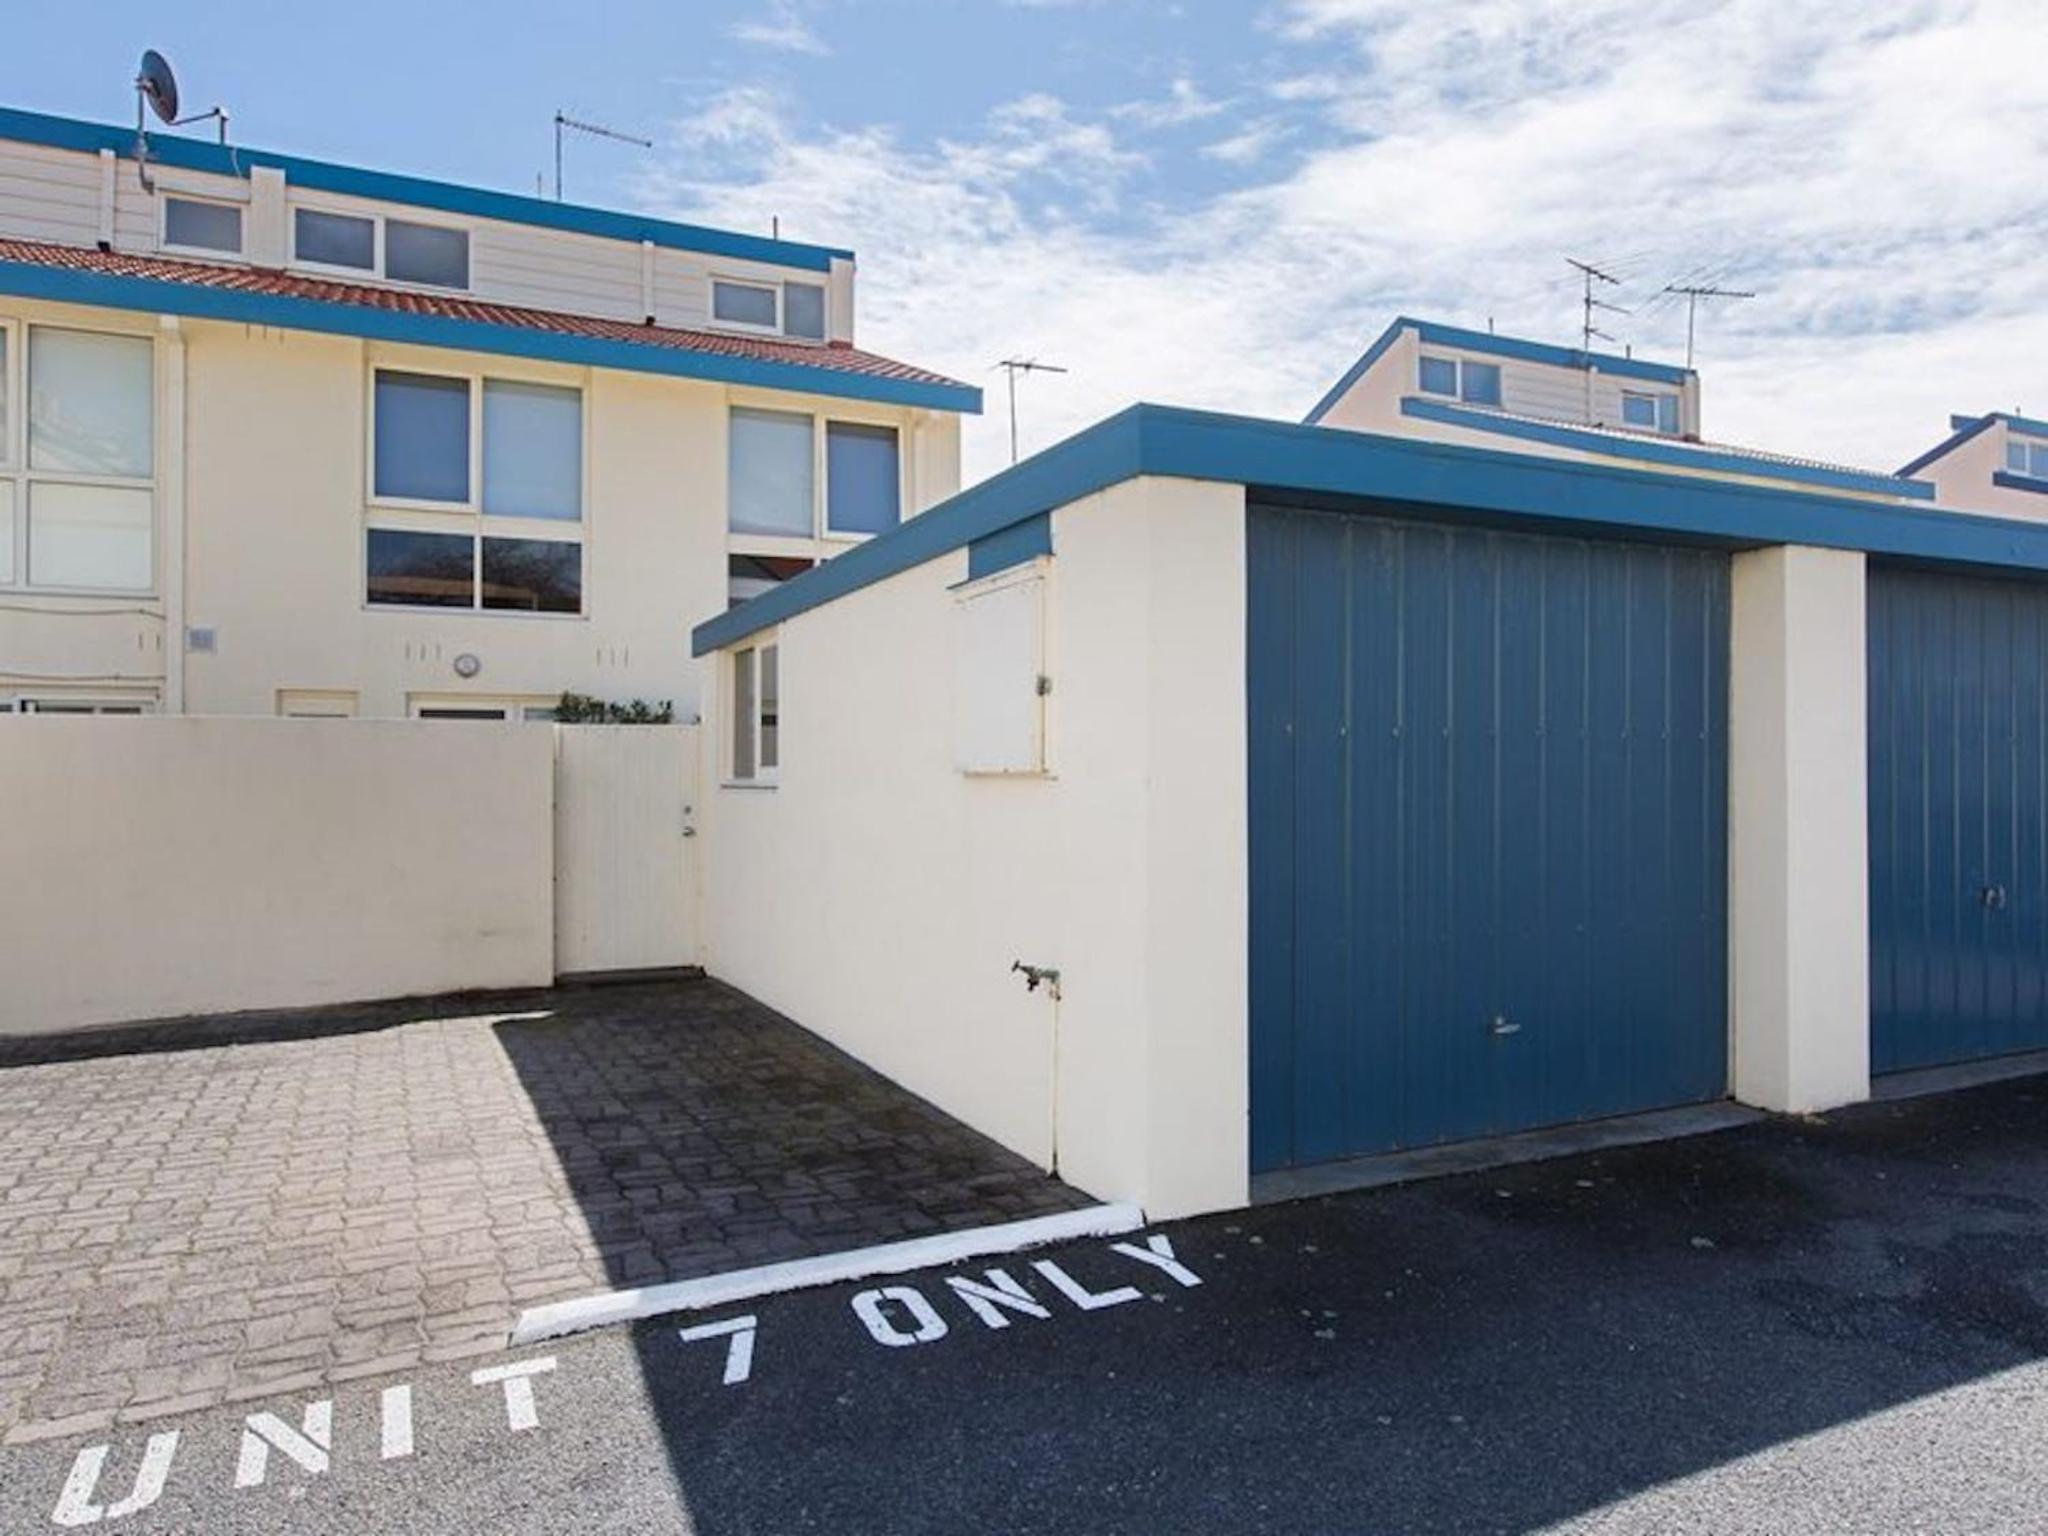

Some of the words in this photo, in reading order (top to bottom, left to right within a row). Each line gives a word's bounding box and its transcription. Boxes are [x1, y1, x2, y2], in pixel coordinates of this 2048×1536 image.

[50, 1355, 559, 1528] UNIT
[679, 1314, 758, 1386] 7
[850, 1233, 1204, 1348] ONLY
